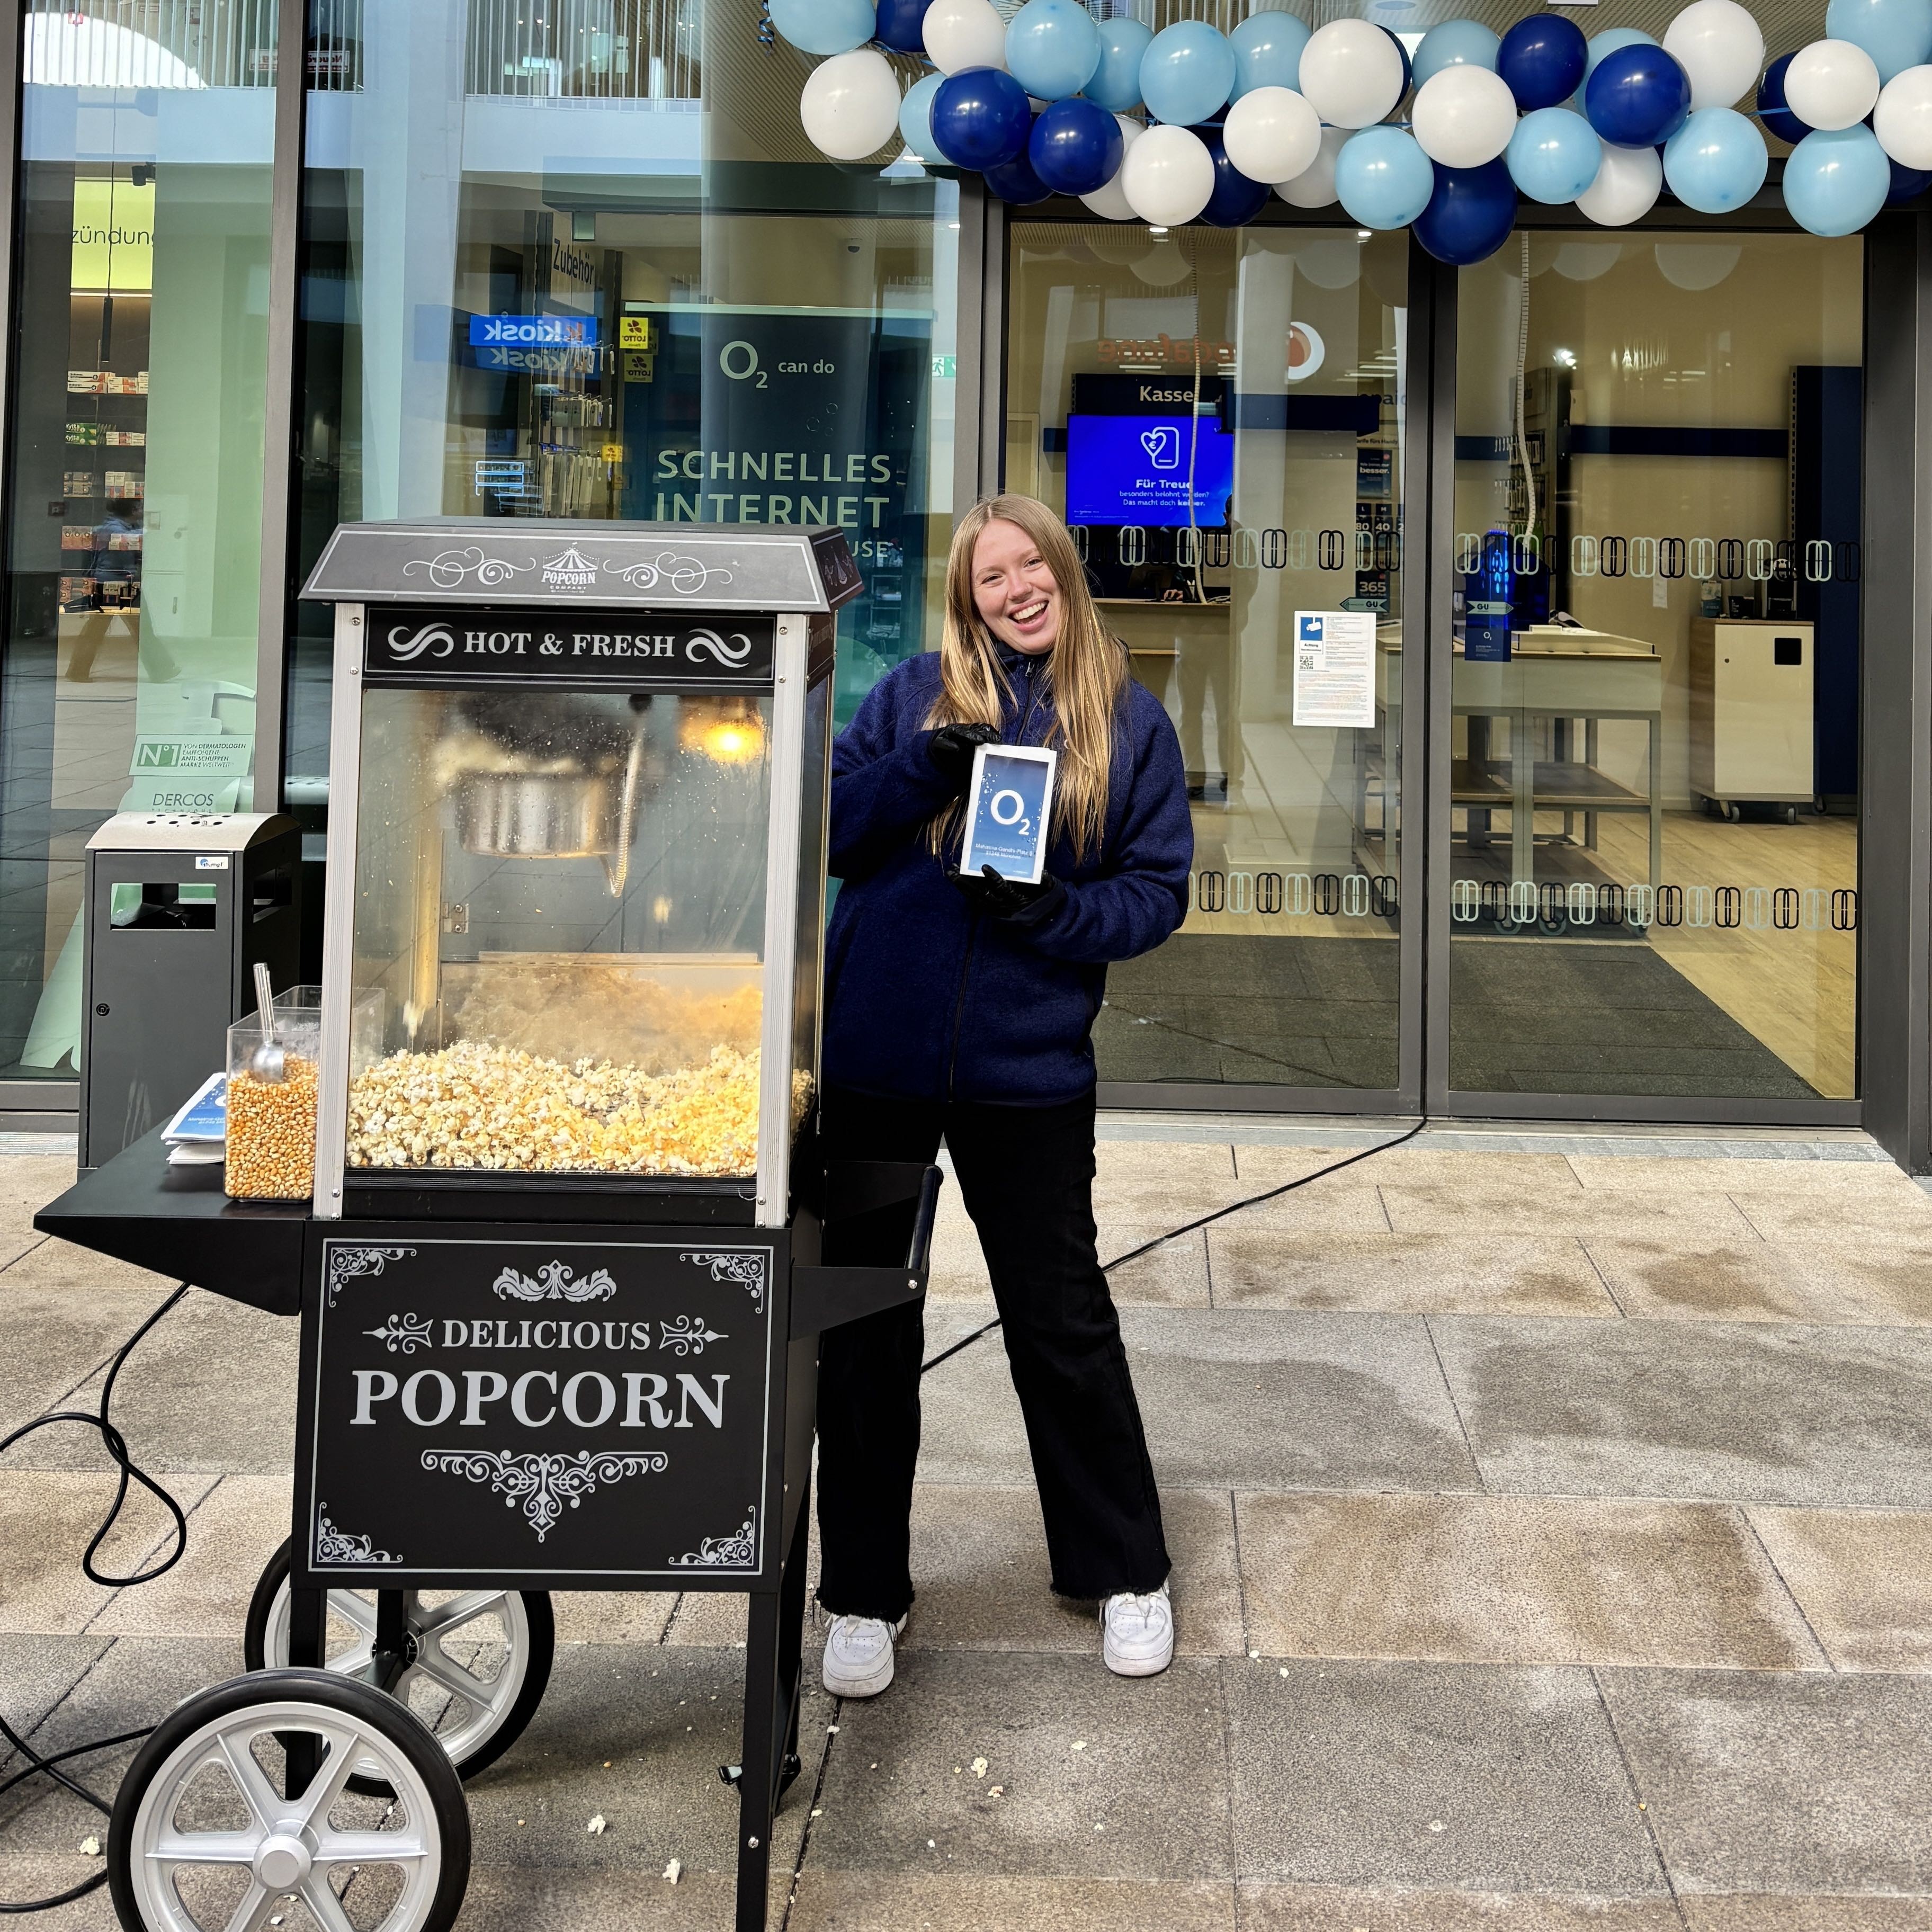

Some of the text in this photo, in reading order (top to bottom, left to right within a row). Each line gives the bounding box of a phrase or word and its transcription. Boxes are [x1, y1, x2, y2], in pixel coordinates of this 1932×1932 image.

[553, 238, 594, 284] Zubehör
[720, 341, 835, 388] O2 can do
[1140, 386, 1194, 402] Kasse
[658, 450, 891, 483] SCHNELLES
[1135, 479, 1156, 488] Für
[657, 493, 889, 528] INTERNET
[846, 541, 889, 557] USE
[541, 571, 596, 585] POPCORN
[1359, 582, 1386, 592] 365
[463, 632, 675, 657] HOT & FRESH
[153, 793, 214, 806] DERCOS
[990, 789, 1031, 835] O2
[442, 1320, 650, 1350] DELICIOUS
[350, 1369, 730, 1428] POPCORN
